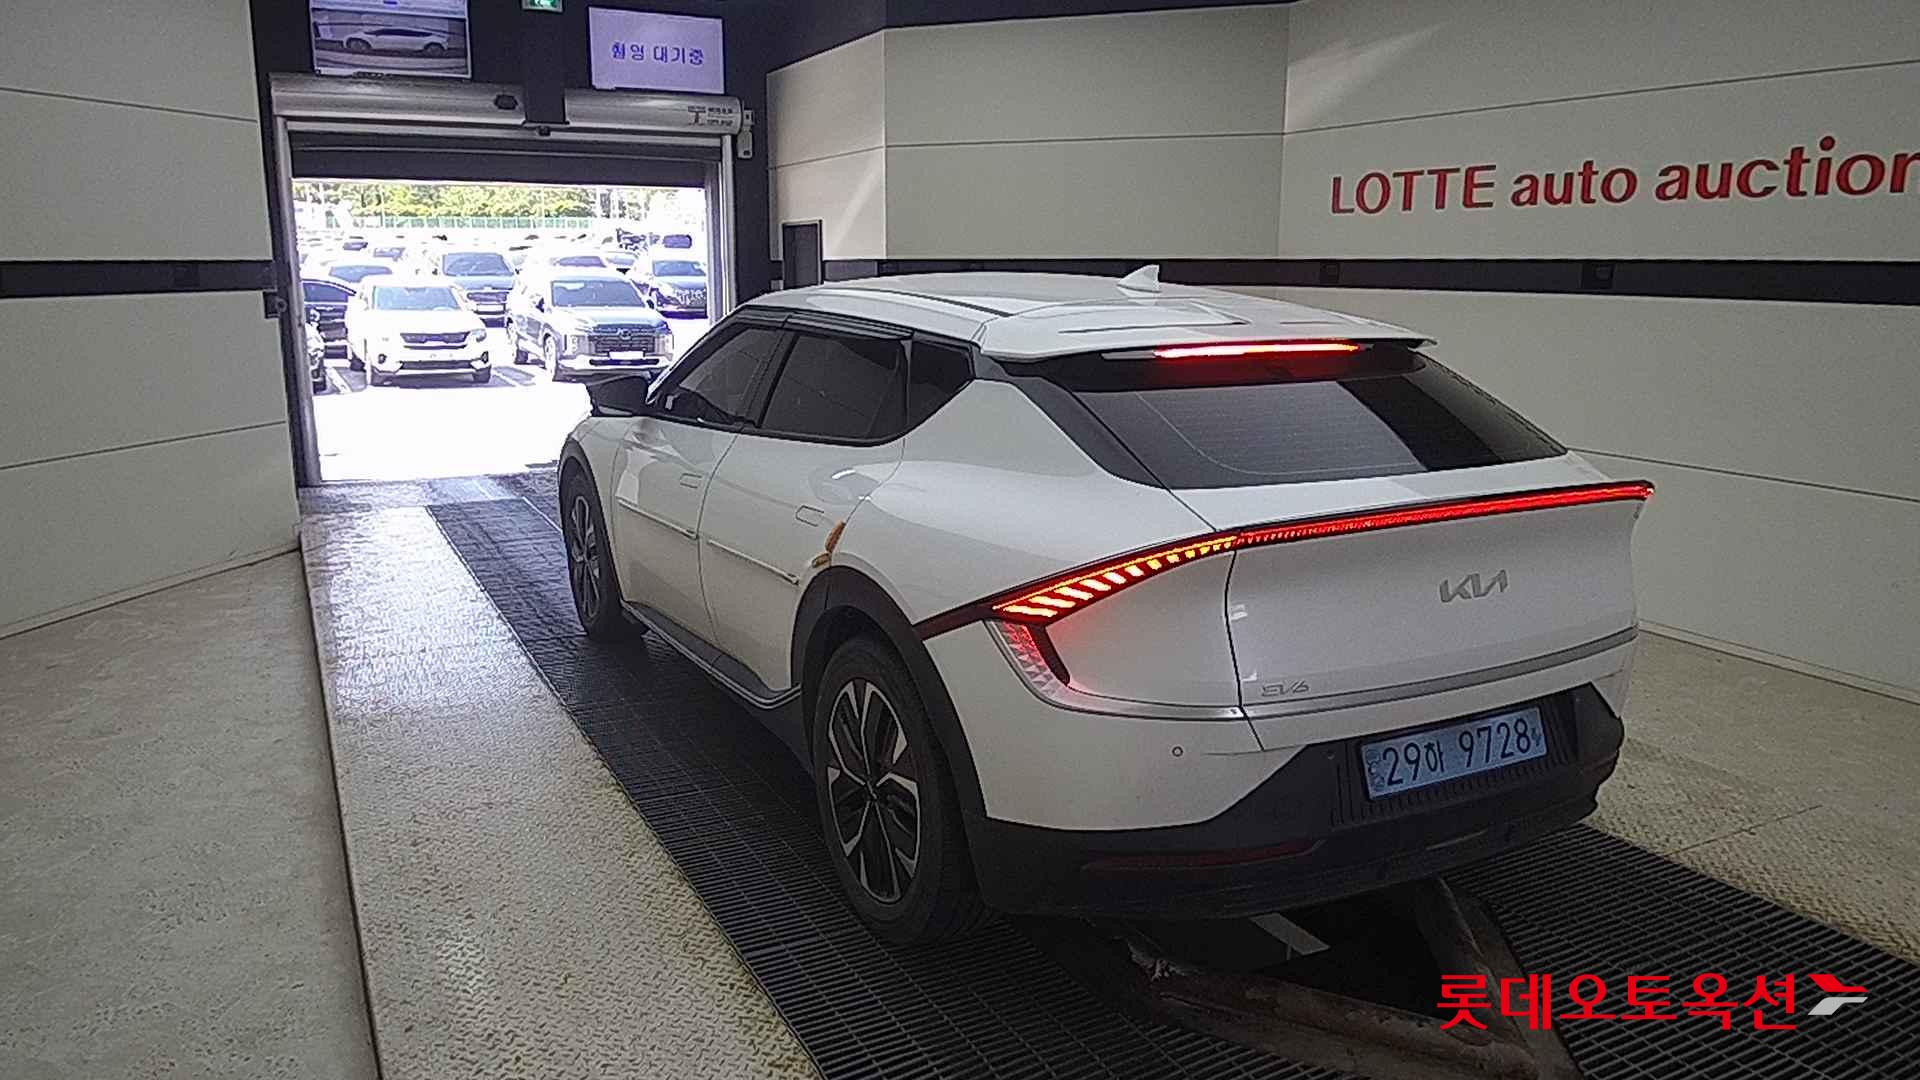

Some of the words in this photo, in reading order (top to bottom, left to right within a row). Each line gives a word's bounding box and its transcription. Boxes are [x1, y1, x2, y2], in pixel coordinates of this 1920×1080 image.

[1331, 164, 1497, 214] LOTTE
[1511, 160, 1637, 207] auto
[1261, 680, 1310, 697] EV6
[1382, 739, 1445, 787] 29하
[1458, 717, 1532, 769] 9728
